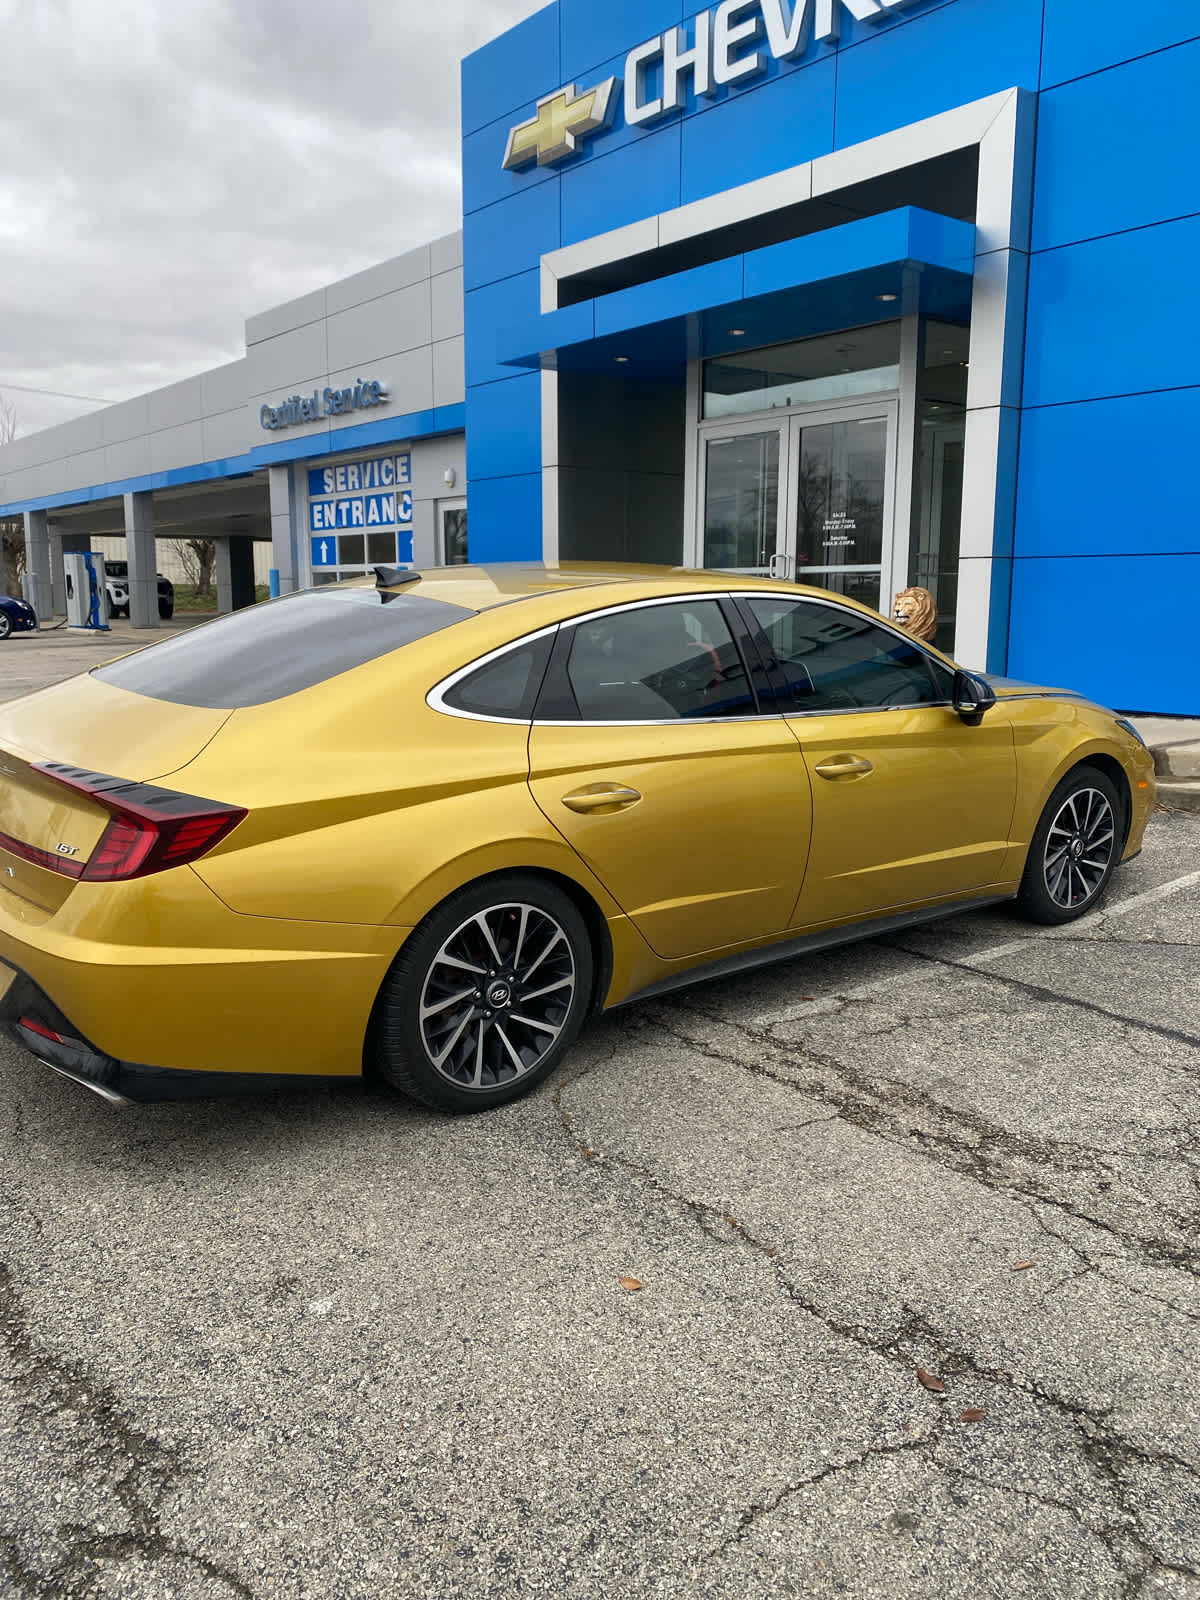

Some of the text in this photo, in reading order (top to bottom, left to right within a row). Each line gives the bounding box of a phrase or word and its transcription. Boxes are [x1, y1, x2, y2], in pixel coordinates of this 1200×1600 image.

[259, 378, 383, 430] Certified Service
[323, 455, 409, 493] SERVICE
